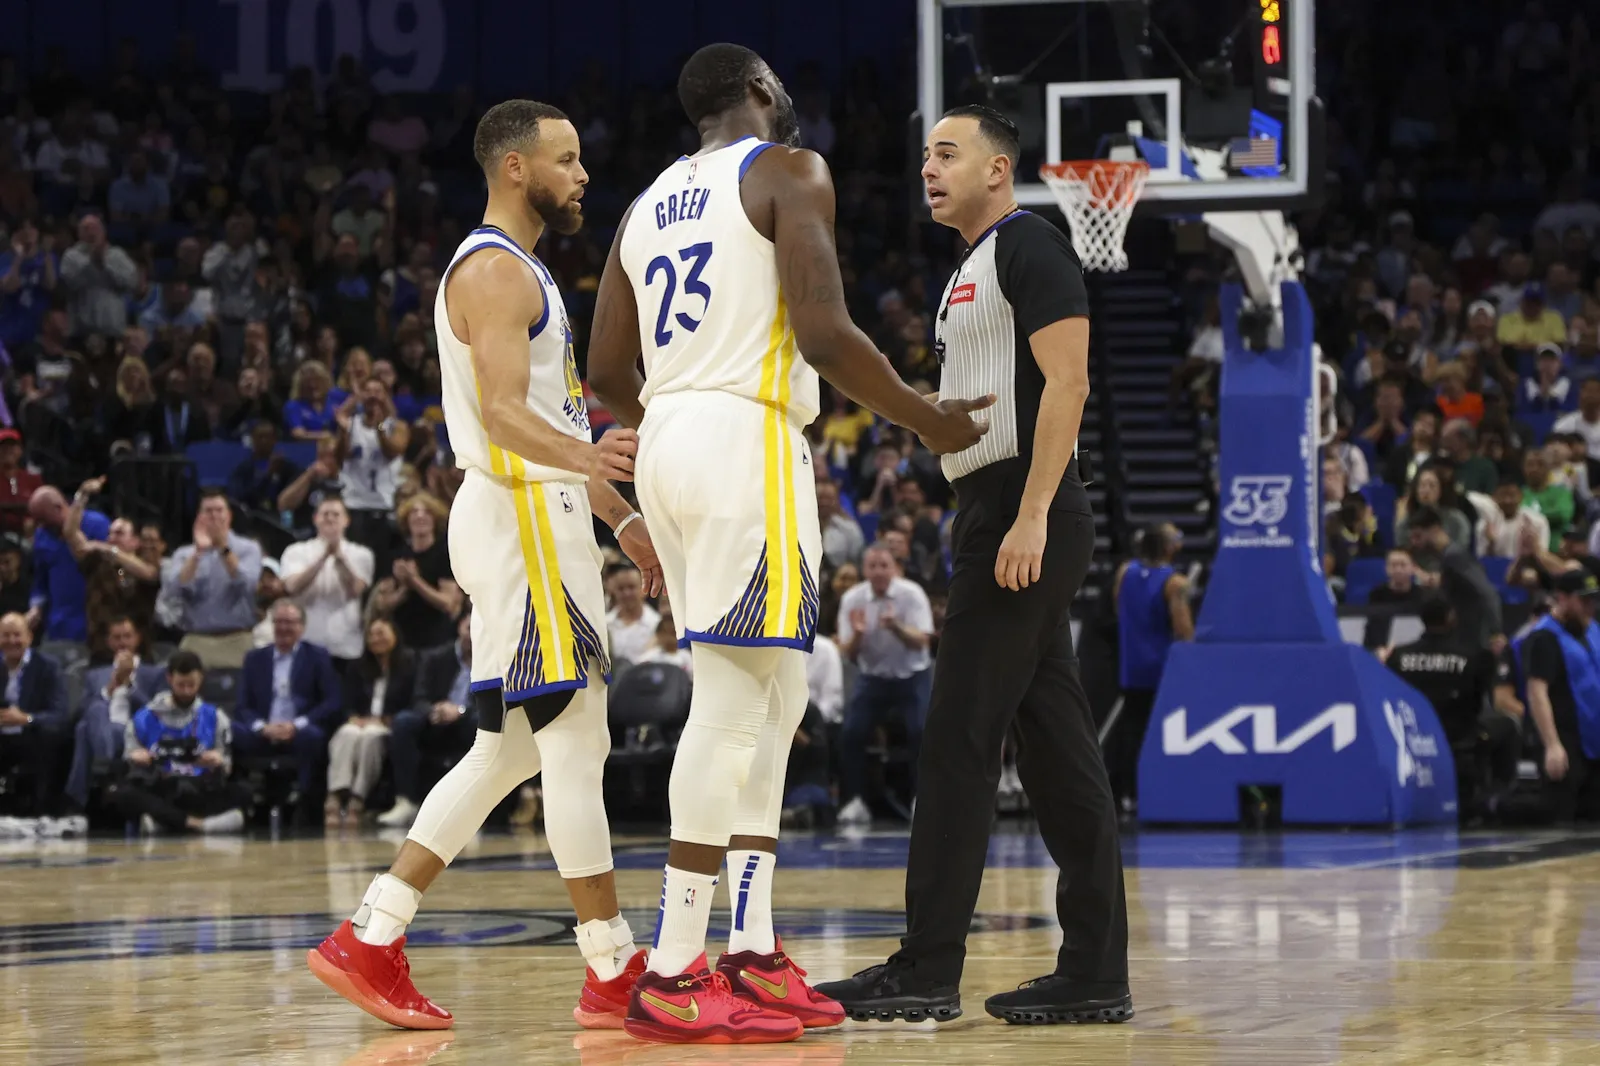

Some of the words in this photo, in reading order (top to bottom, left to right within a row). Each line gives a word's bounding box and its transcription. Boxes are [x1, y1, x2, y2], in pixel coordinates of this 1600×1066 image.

[217, 0, 447, 93] 109
[655, 188, 711, 231] GREEN
[645, 241, 713, 348] 23
[1401, 652, 1468, 674] SECURITY
